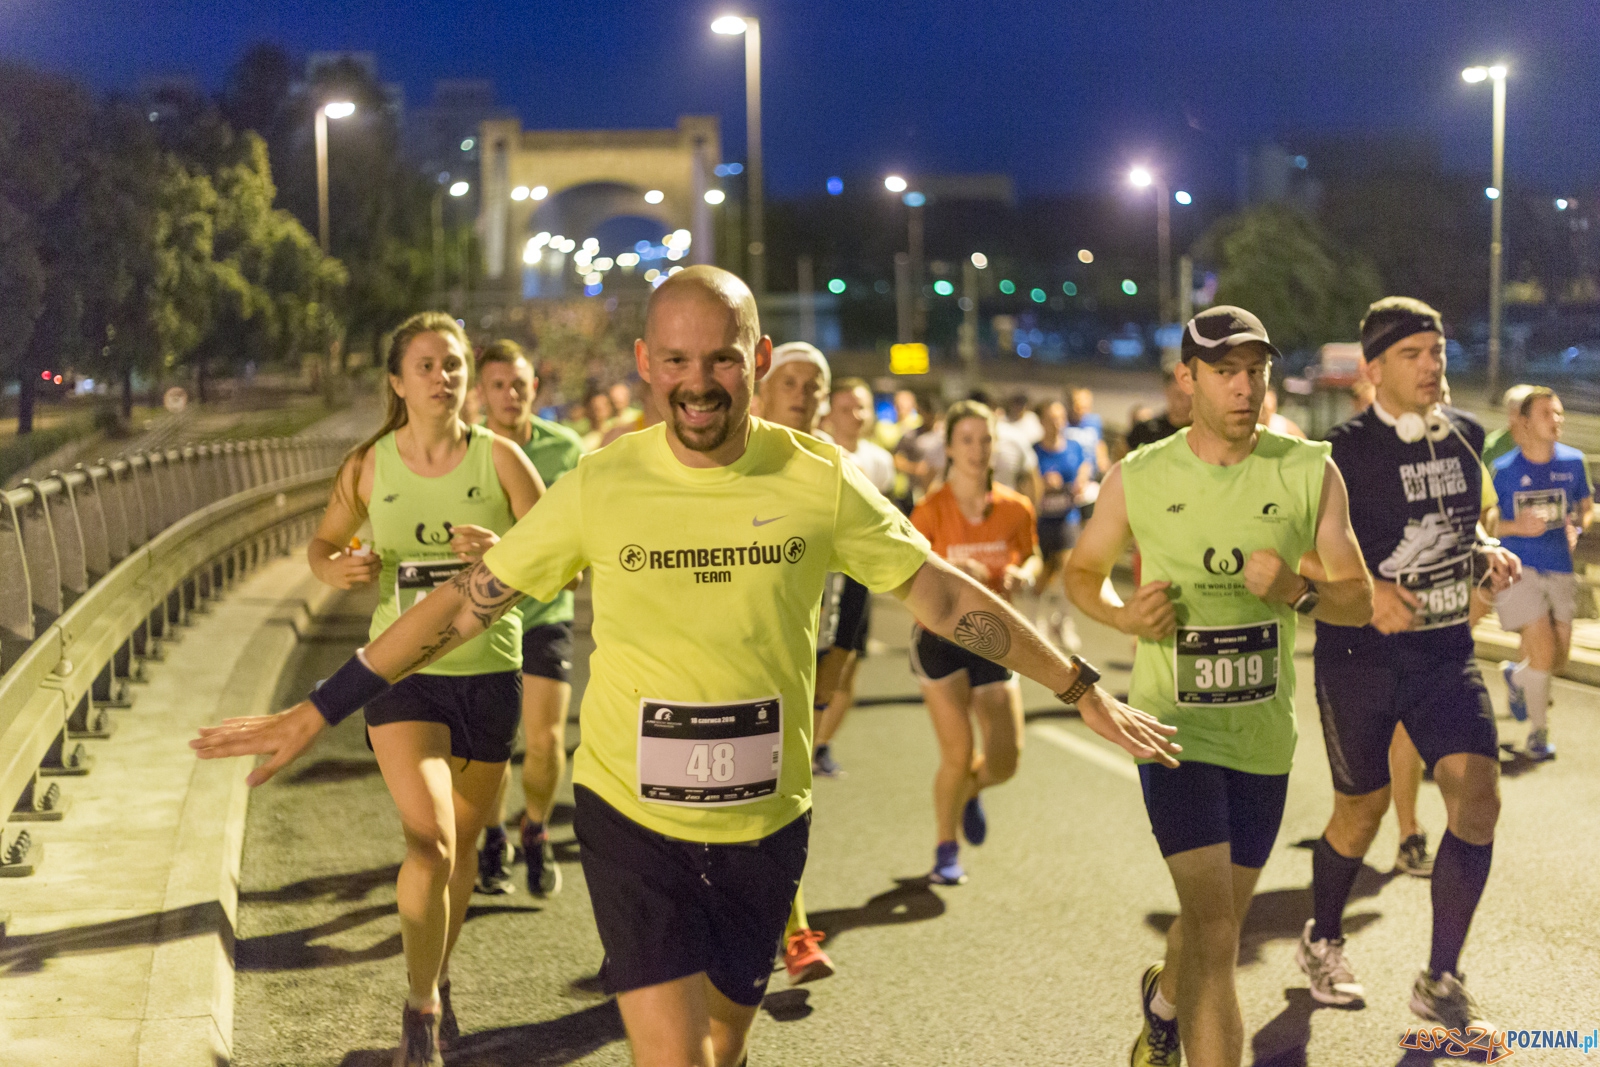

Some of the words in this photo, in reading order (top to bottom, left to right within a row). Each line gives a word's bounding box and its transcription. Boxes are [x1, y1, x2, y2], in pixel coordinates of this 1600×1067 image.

[1166, 503, 1186, 514] 4F
[649, 541, 782, 569] REMBERTÓW
[693, 570, 732, 584] TEAM
[1415, 581, 1469, 615] 2653
[1195, 655, 1263, 689] 3019
[686, 742, 736, 783] 48
